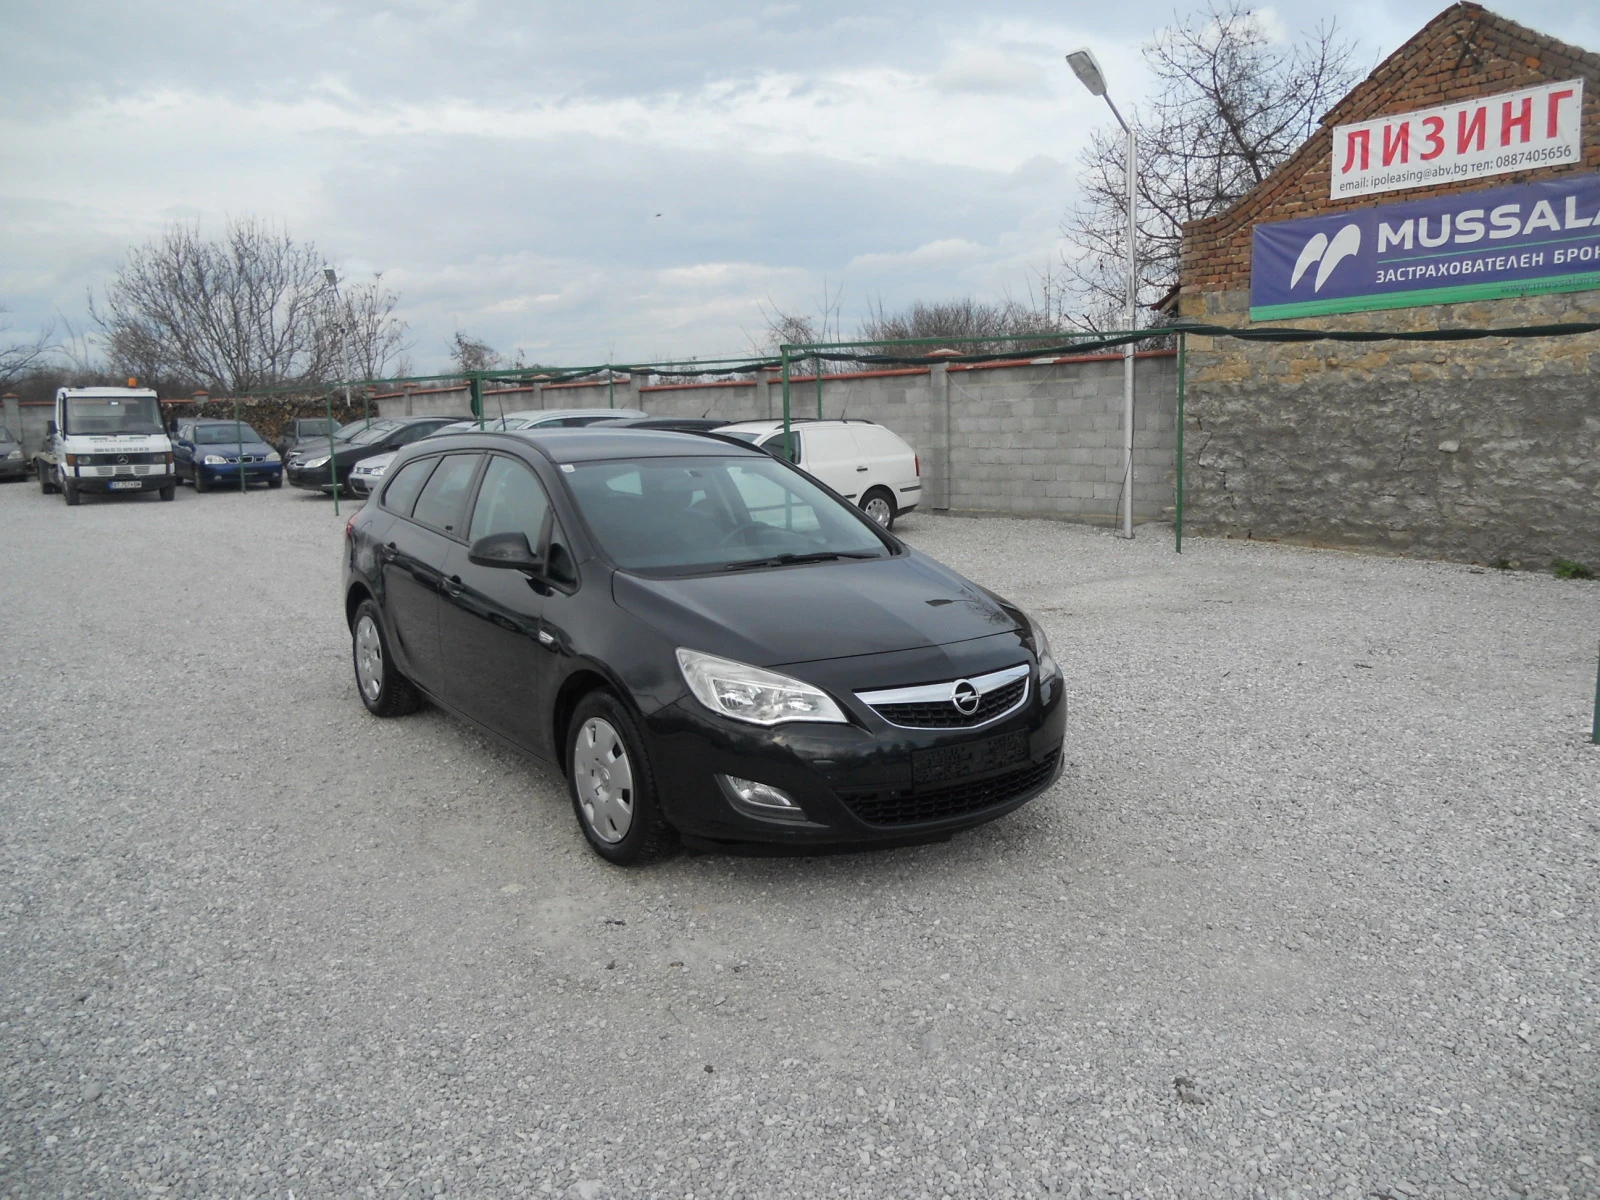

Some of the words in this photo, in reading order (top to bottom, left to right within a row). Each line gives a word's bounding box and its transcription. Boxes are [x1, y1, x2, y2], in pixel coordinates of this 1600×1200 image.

[1341, 89, 1573, 174] ЛИЗИНГ
[1339, 177, 1369, 191] email:
[1370, 162, 1468, 188] ipoleasing@abv.bg
[1470, 161, 1493, 173] тел:
[1495, 144, 1571, 168] 0887405656
[1377, 195, 1600, 253] MUSSAL
[1375, 252, 1544, 284] ЗАСТРАХОВАТЕЛЕН
